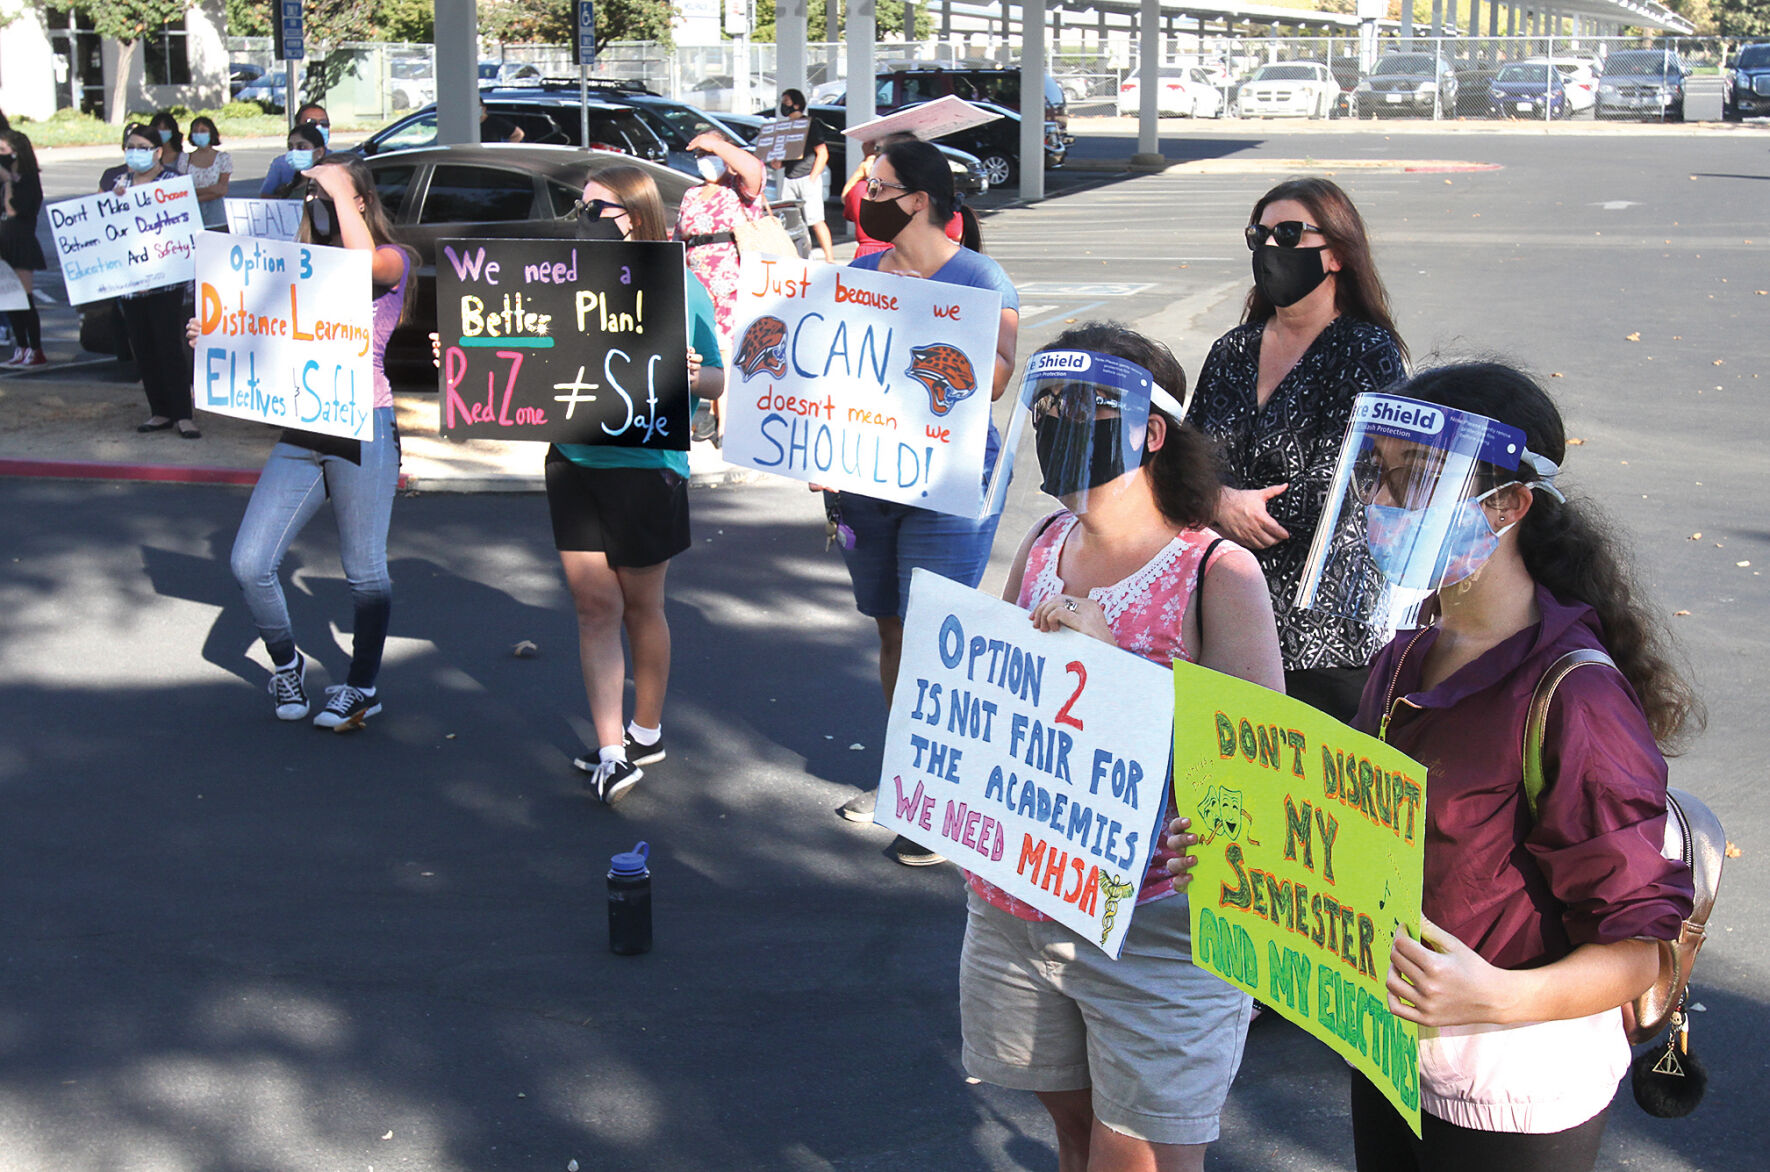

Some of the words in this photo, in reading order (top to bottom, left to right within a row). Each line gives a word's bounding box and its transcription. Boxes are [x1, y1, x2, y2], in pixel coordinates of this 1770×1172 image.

[97, 198, 130, 218] Make
[105, 224, 128, 241] Our
[230, 201, 303, 237] HEALT
[128, 247, 149, 266] And
[230, 242, 285, 286] Option
[300, 248, 313, 279] 3
[444, 245, 500, 285] We
[524, 248, 577, 284] need
[619, 265, 631, 285] a
[752, 260, 811, 299] Just
[835, 272, 899, 311] because
[933, 302, 961, 321] we
[201, 282, 287, 337] Distance
[290, 283, 370, 357] Learning
[461, 291, 552, 337] Better
[576, 289, 643, 334] Plan!
[792, 312, 893, 394] CAN,
[1038, 354, 1084, 369] Shield
[301, 359, 368, 436] Safety
[601, 348, 669, 443] Safe
[757, 384, 835, 421] doesn't
[848, 406, 897, 430] mean
[926, 424, 950, 443] we
[1371, 402, 1436, 430] Shield
[1377, 425, 1411, 438] Protection
[753, 413, 934, 498] SHOULD!
[938, 613, 1046, 707] OPTION
[1054, 660, 1088, 731] 2
[911, 678, 942, 726] IS
[947, 688, 998, 743] NOT
[1009, 713, 1073, 785] FAIR
[1089, 748, 1144, 810] FOR
[1214, 710, 1306, 780] DON'T
[1321, 744, 1422, 848] DISRUPT
[910, 733, 963, 784] THE
[984, 765, 1139, 871] ACADEMIES
[893, 775, 937, 831] WE
[942, 799, 1004, 862] NEED
[1017, 833, 1100, 917] MHSA
[1284, 793, 1339, 887] MY
[1219, 842, 1378, 982] SEMESTER
[1199, 907, 1258, 989] AND
[1267, 939, 1311, 1018] MY
[1318, 964, 1418, 1112] ELECTIVES
